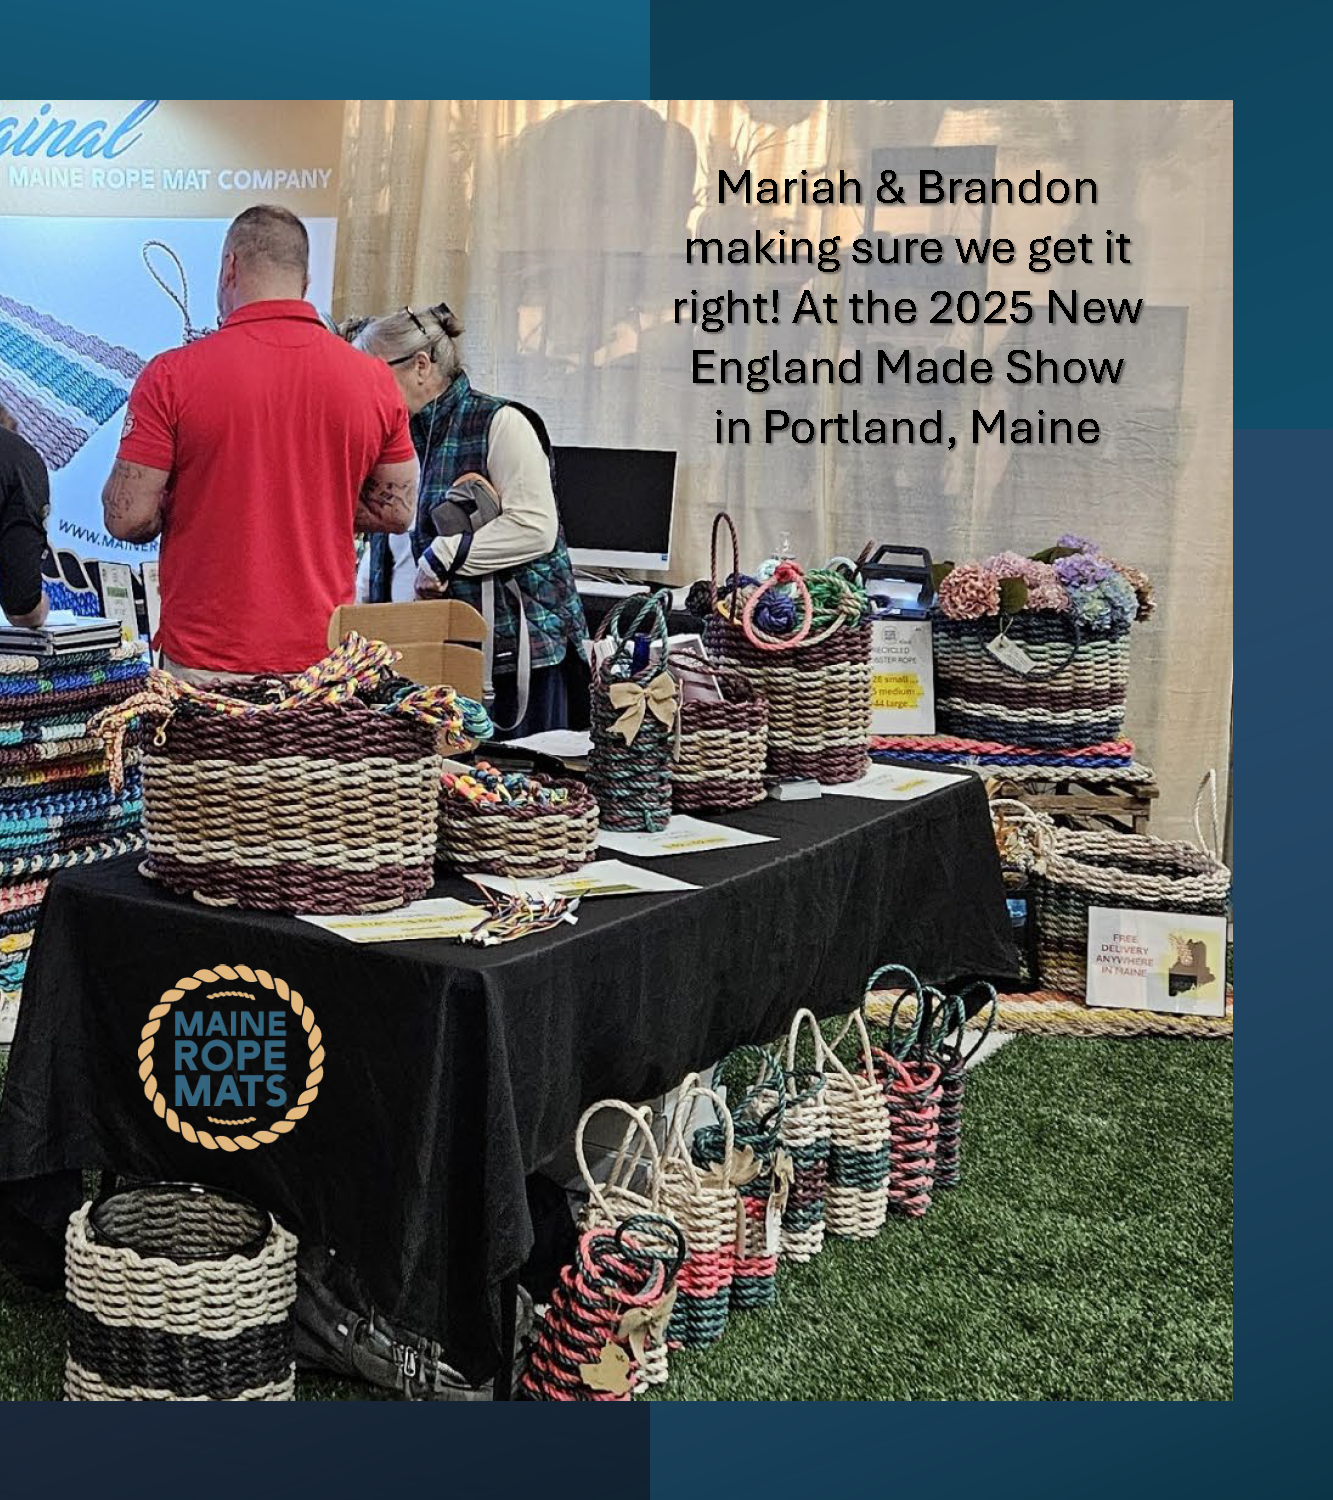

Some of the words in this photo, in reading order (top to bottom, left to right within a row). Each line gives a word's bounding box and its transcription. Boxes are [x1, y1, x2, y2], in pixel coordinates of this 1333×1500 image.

[9, 166, 84, 189] MAINE
[92, 167, 155, 190] ROPE
[163, 168, 212, 190] MAT
[217, 168, 333, 190] COMPANY
[1113, 933, 1138, 944] FREE
[1101, 944, 1149, 955] DELIVERY
[1096, 955, 1154, 967] ANYWHERE
